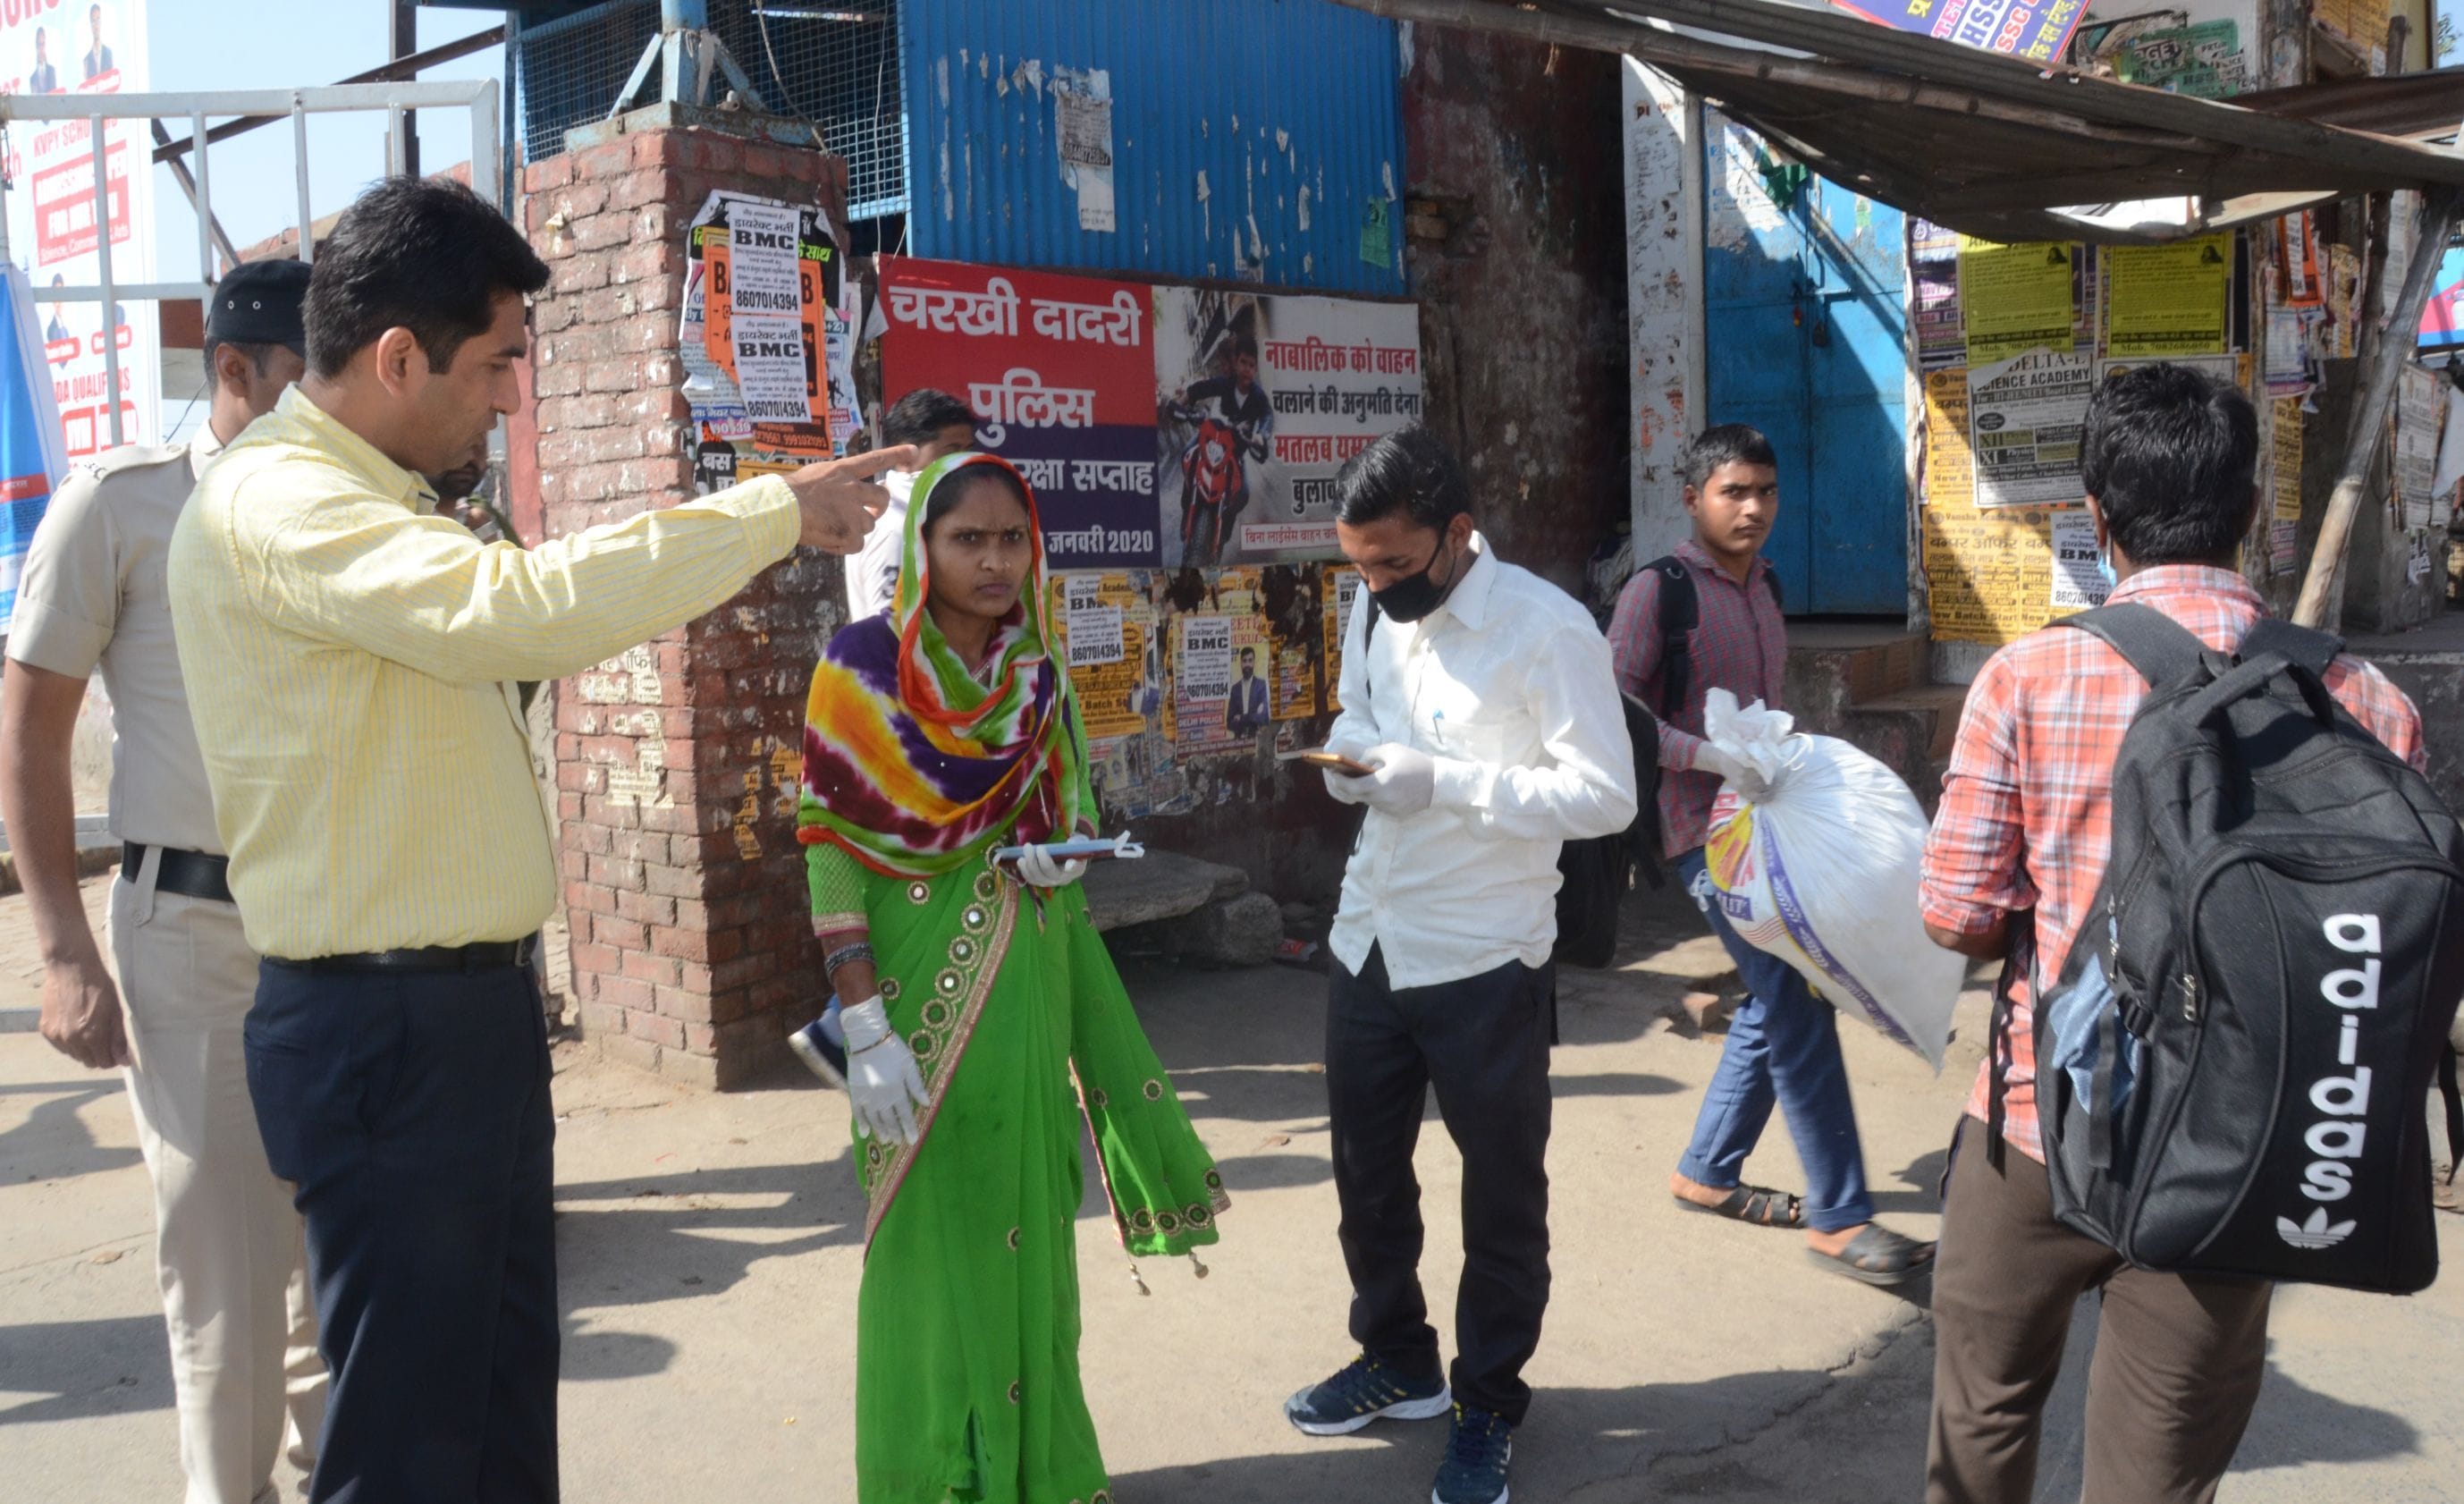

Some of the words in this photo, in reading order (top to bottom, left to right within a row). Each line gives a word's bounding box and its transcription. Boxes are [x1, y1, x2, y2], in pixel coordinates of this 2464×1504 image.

[735, 230, 794, 249] BMC
[736, 289, 797, 311] 8607014394
[889, 276, 1020, 336] चरखी
[1031, 291, 1143, 346] दादरी
[738, 342, 800, 358] BMC
[1350, 338, 1372, 374] को
[2030, 368, 2090, 385] ACADEMY
[747, 401, 807, 418] 8607014394
[968, 368, 1095, 447] पुलिस
[1272, 384, 1315, 415] चलाने
[1319, 385, 1338, 415] की
[1342, 386, 1392, 423] अनुमति
[1395, 386, 1420, 416] देना
[1275, 435, 1333, 463] मतलब
[1980, 451, 1998, 465] XI
[1071, 460, 1155, 495] सप्ताह
[1048, 524, 1105, 553] जनवरी
[1108, 530, 1153, 553] 2020
[2060, 548, 2097, 561] BM
[2055, 590, 2108, 606] 860701439
[1955, 612, 1987, 620] Batch
[2021, 613, 2045, 621] New
[1073, 643, 1121, 662] 8607014394
[1187, 638, 1228, 650] BMC
[2299, 913, 2382, 1201] adidas
